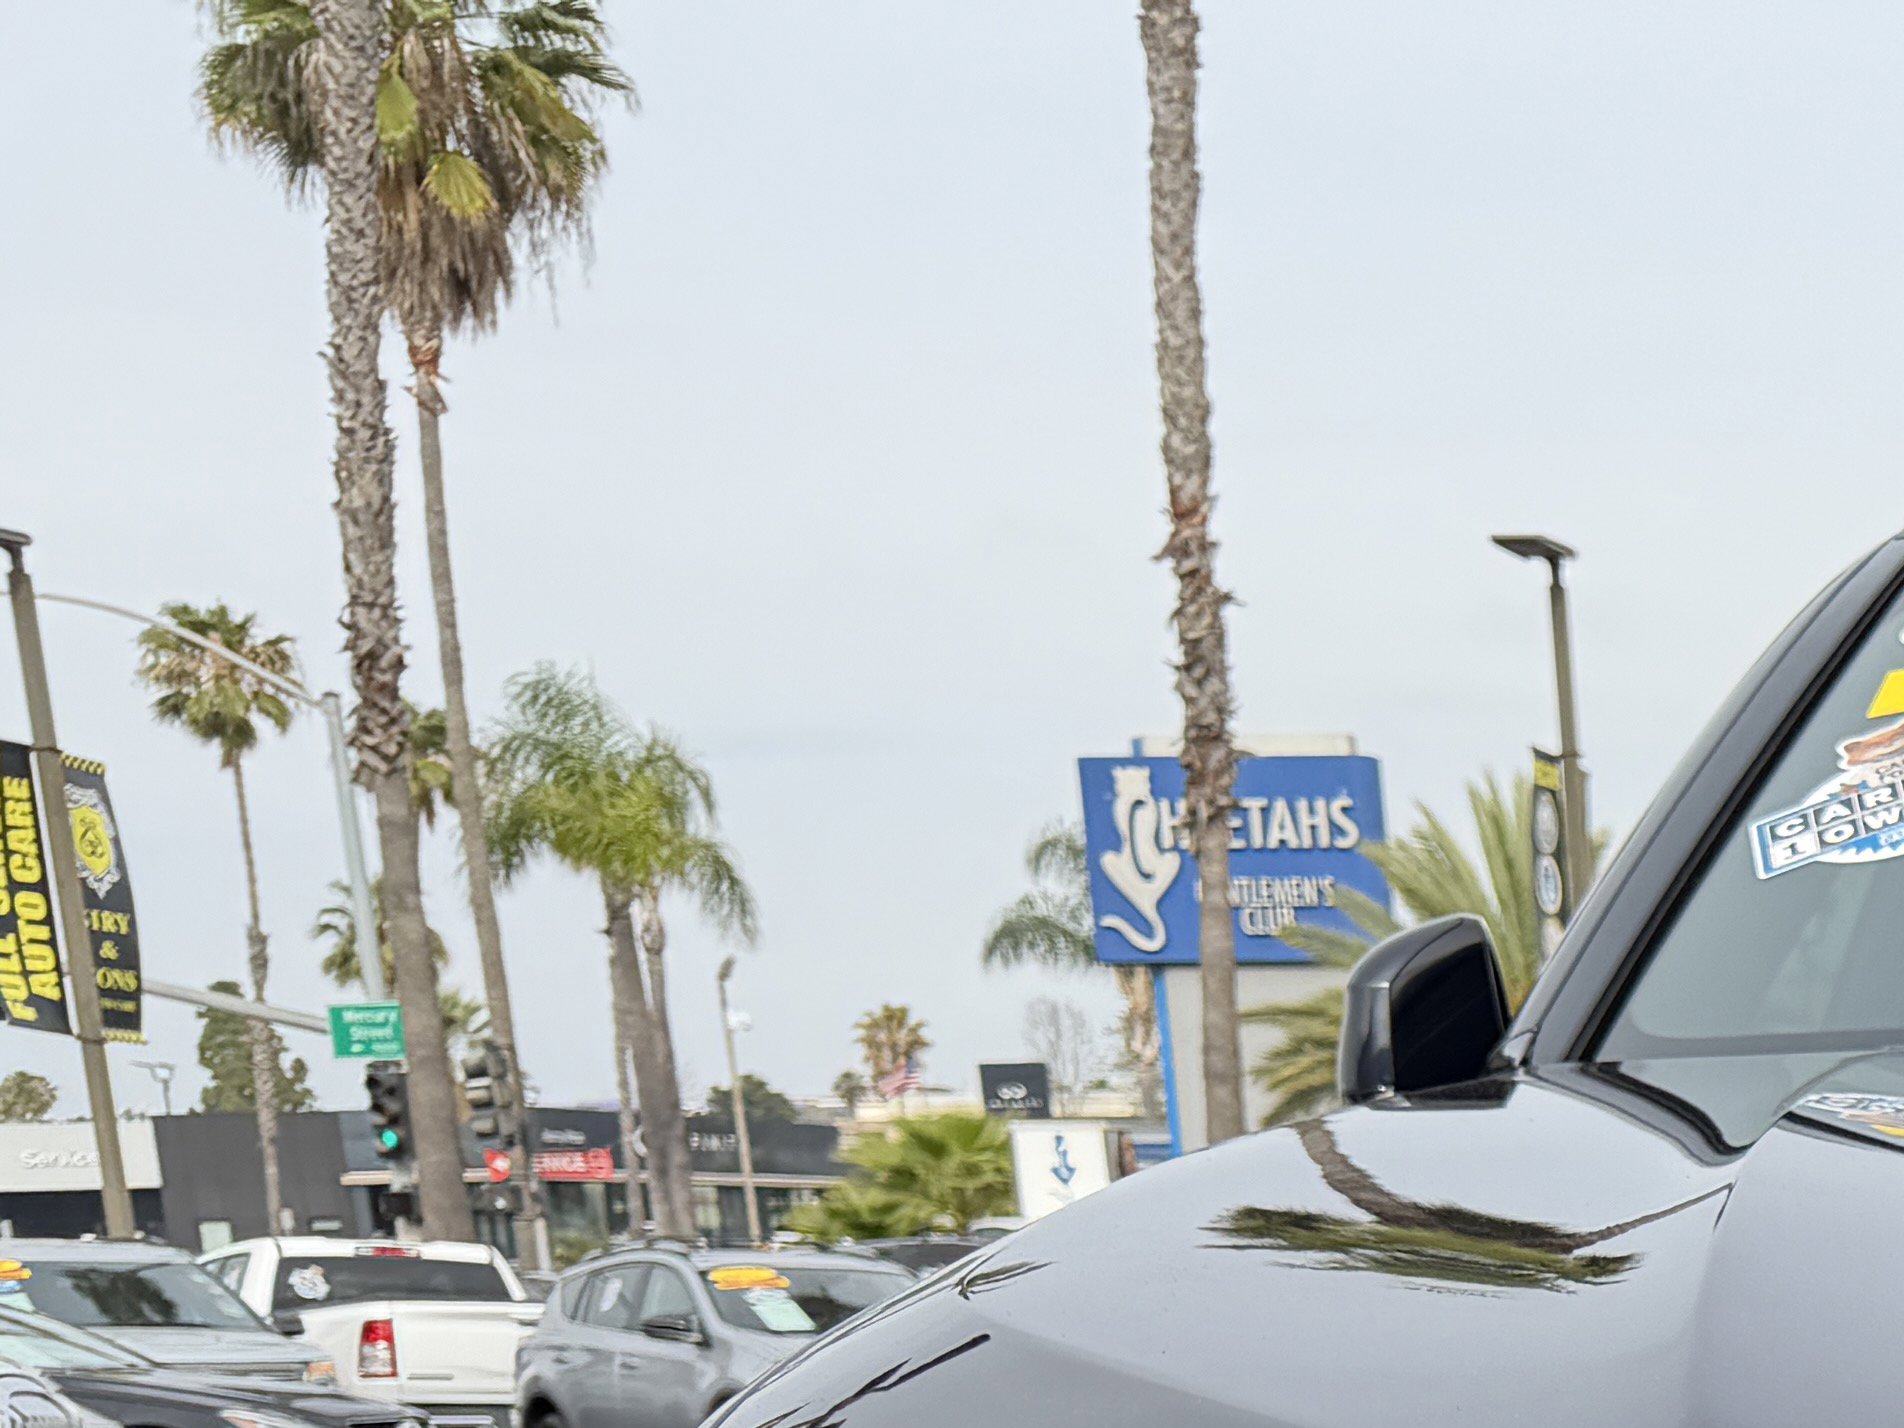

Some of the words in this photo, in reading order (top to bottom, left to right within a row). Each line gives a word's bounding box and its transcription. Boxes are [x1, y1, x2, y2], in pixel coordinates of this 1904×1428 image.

[2, 775, 42, 884] CARE
[14, 890, 62, 1001] AUTO
[84, 908, 131, 935] IRY
[99, 940, 119, 960] &
